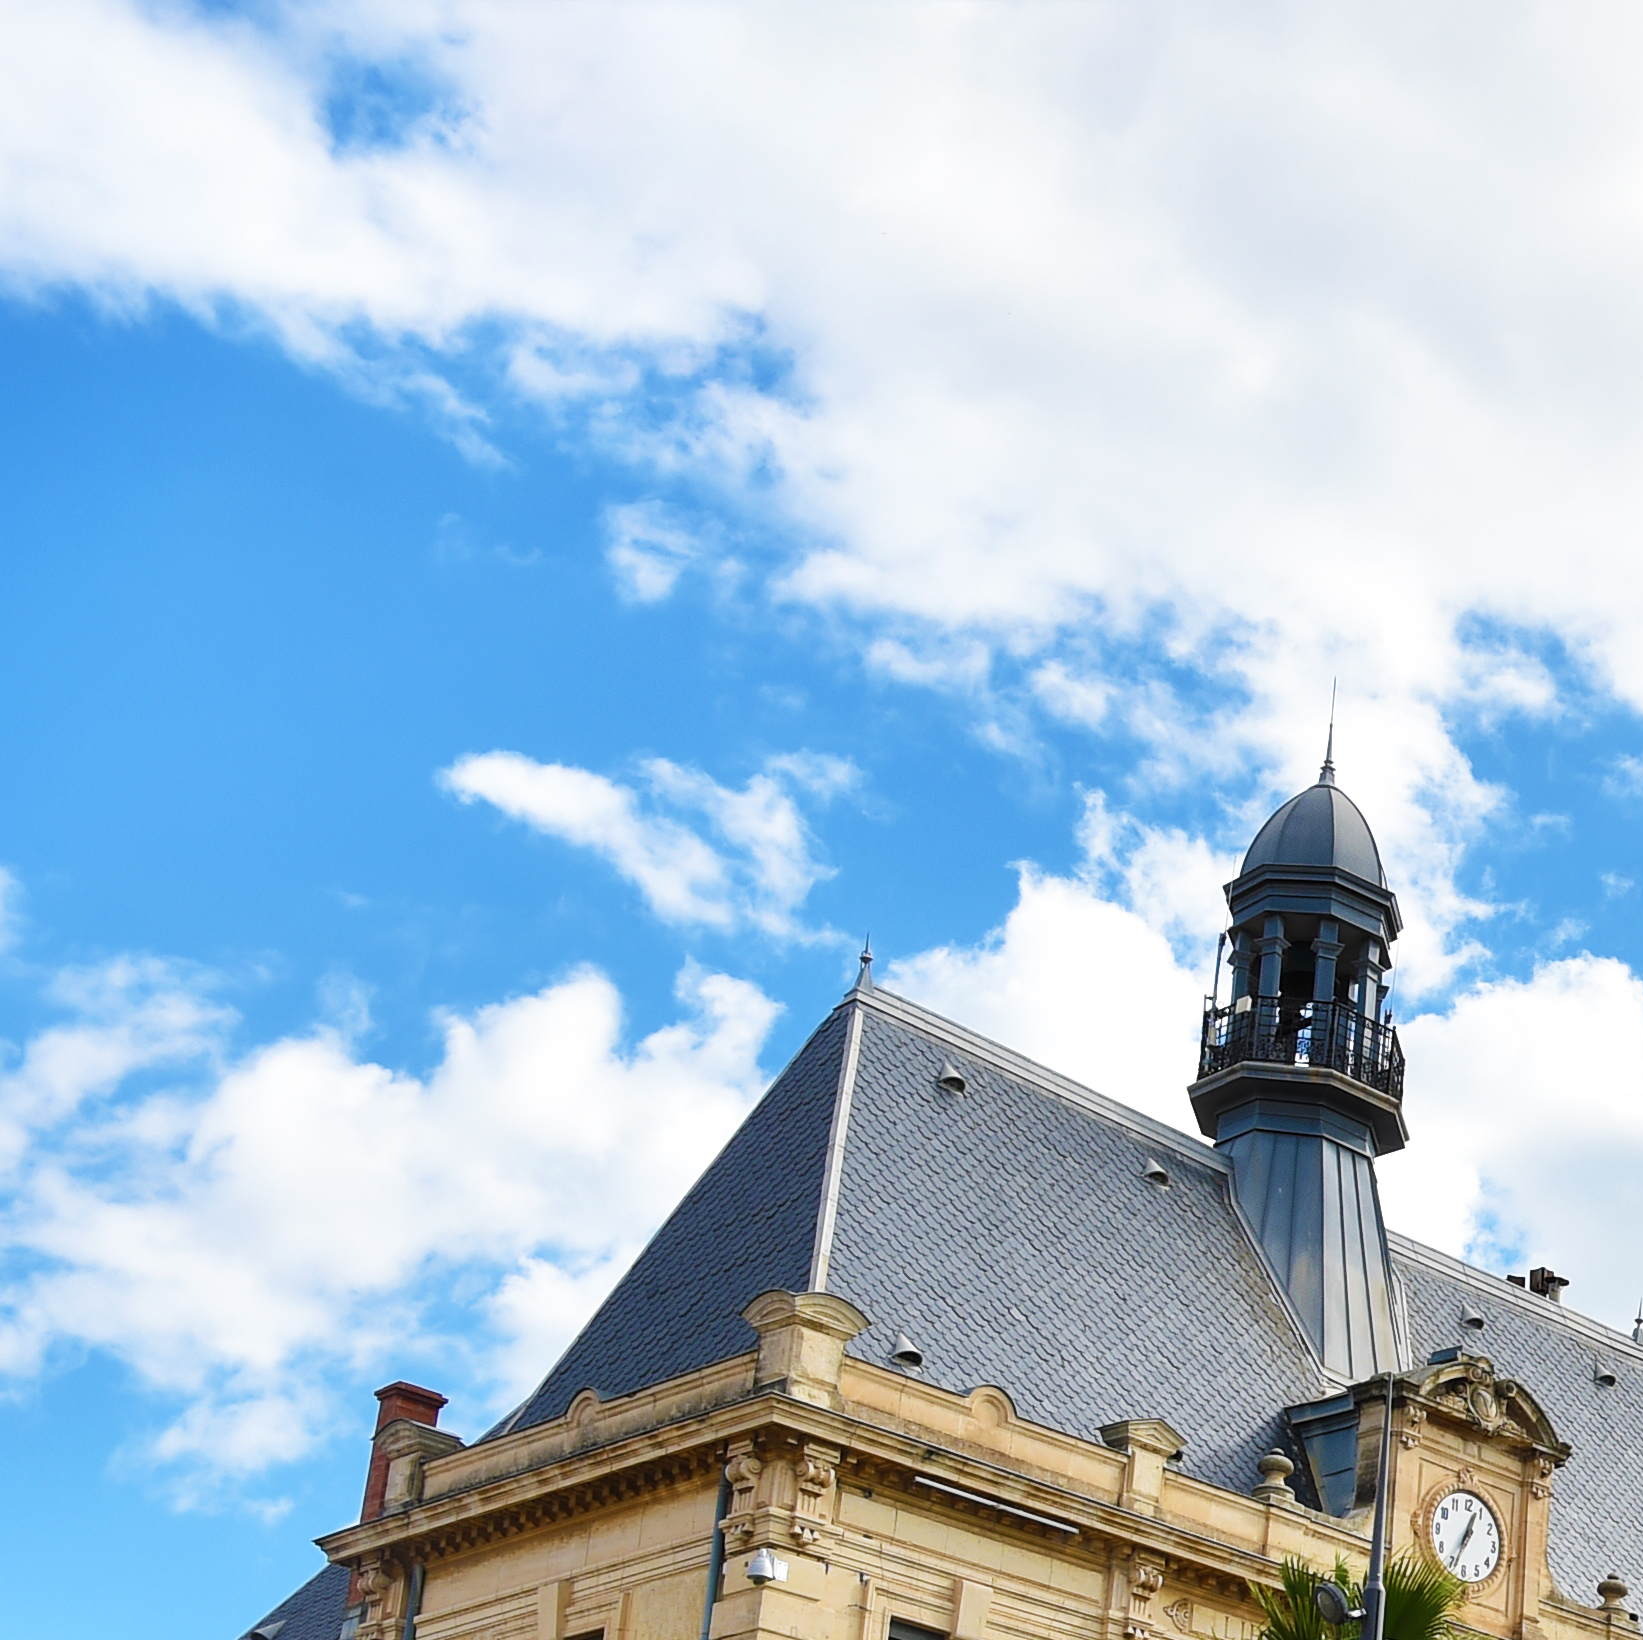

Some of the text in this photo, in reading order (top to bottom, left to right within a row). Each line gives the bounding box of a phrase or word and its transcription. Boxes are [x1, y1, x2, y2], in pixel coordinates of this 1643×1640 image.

[1452, 1498, 1458, 1512] 11
[1464, 1499, 1473, 1512] 12
[1441, 1506, 1449, 1520] 10
[1486, 1522, 1493, 1536] 2
[1438, 1540, 1444, 1554] 8
[1490, 1540, 1496, 1554] 3
[1448, 1555, 1455, 1569] 7
[1484, 1556, 1490, 1569] 4
[1461, 1564, 1466, 1578] 6
[1473, 1564, 1480, 1578] 5
